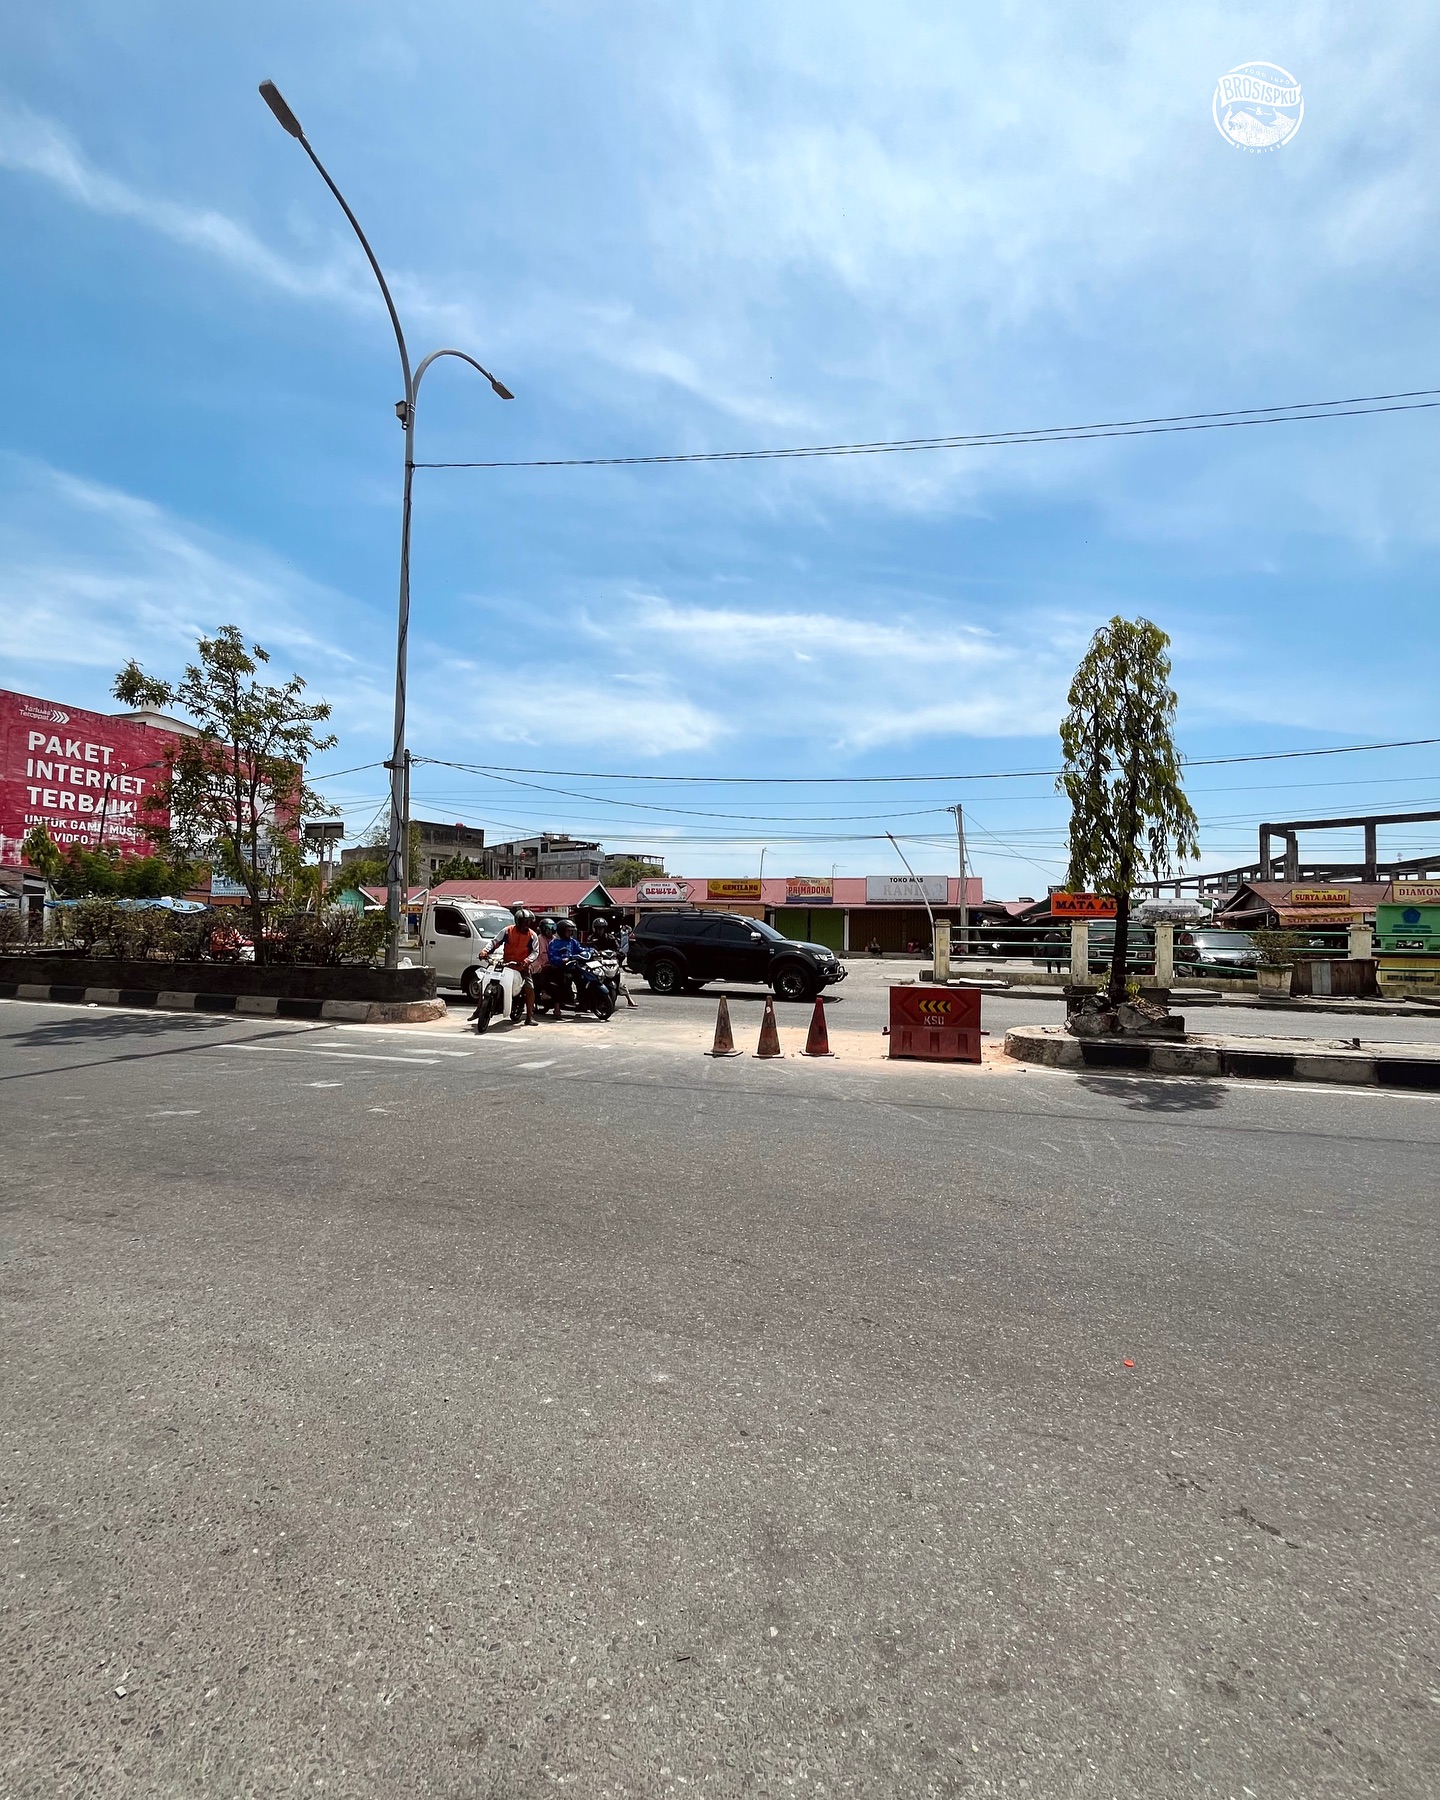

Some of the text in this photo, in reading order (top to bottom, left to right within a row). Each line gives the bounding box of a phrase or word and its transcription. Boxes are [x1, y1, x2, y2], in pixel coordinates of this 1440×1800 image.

[28, 730, 114, 766] PAKET
[26, 758, 146, 795] INTERNET
[26, 785, 134, 818] TERBAIK
[24, 814, 67, 829] UNTUK
[53, 831, 89, 844] VIDEO
[788, 886, 831, 894] PRIMADONA
[883, 884, 930, 896] RANIA
[1055, 900, 1096, 909] MATA
